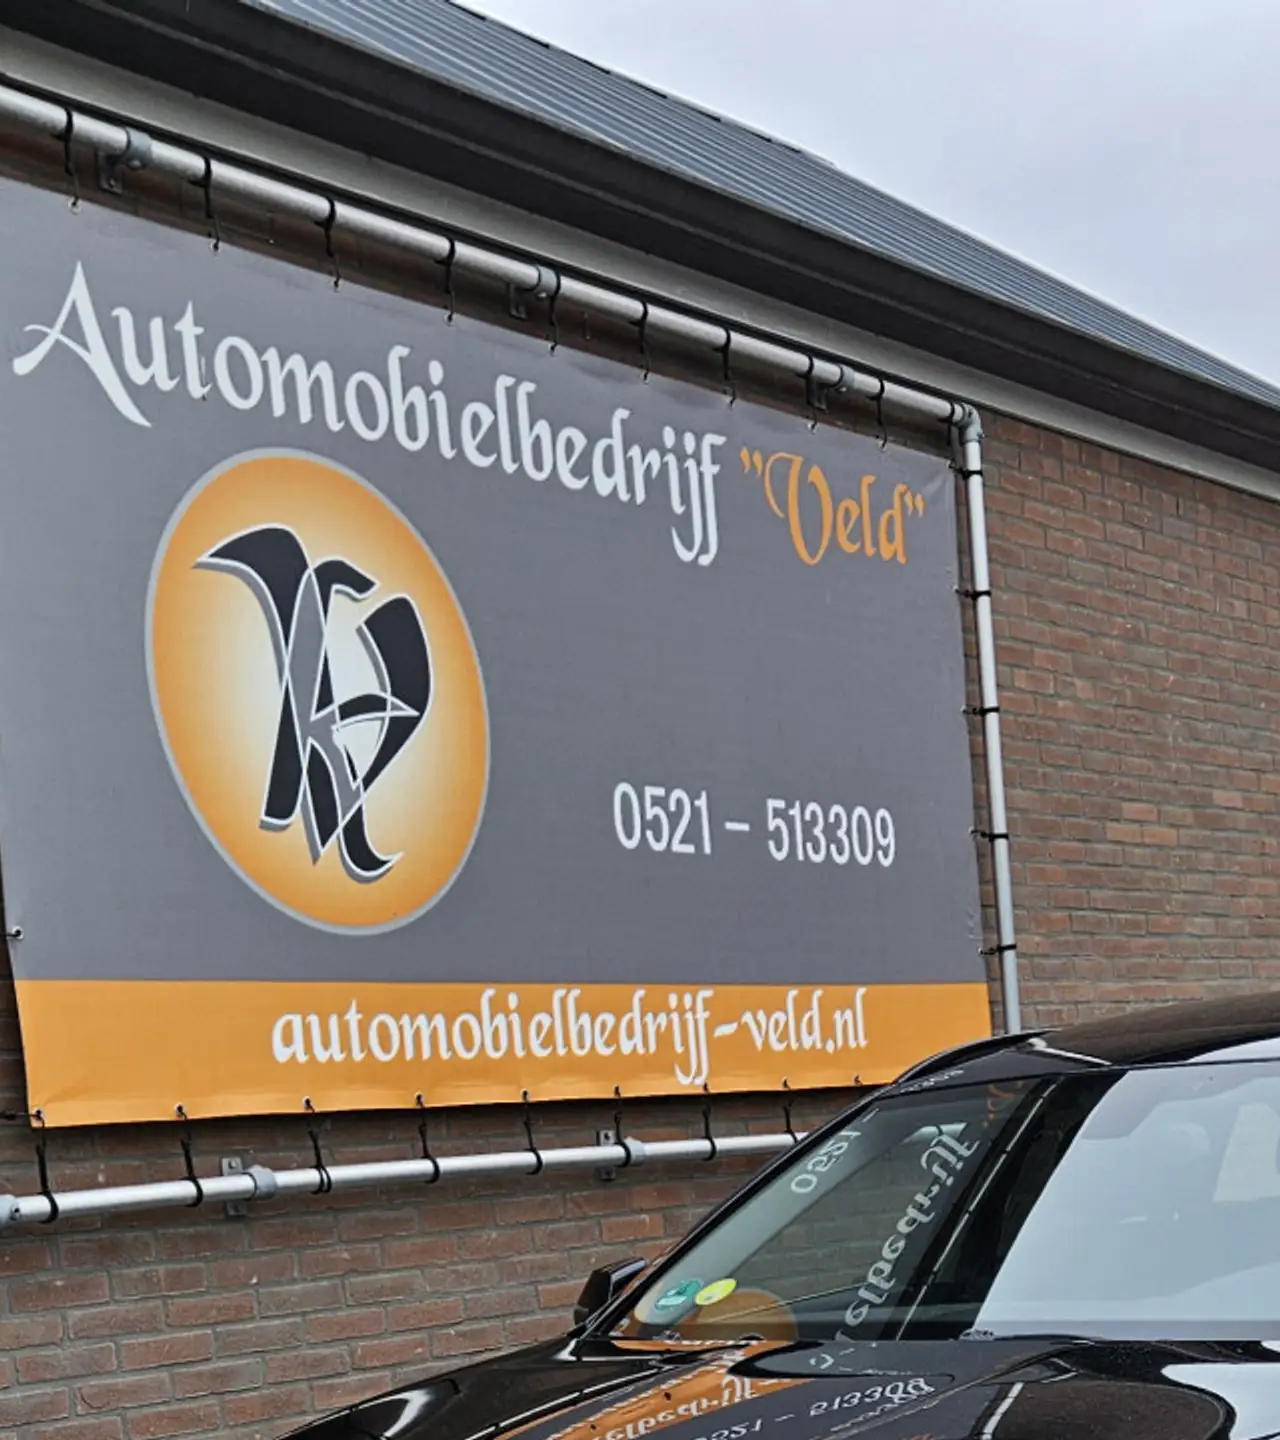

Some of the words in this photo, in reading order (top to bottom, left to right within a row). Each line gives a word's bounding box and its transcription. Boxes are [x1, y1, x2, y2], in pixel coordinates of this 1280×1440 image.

[12, 260, 727, 567] Automobielbedrijf
[613, 781, 712, 855] 0521
[766, 799, 896, 868] 513309
[271, 987, 868, 1086] automobielbedrijf-veld.nl
